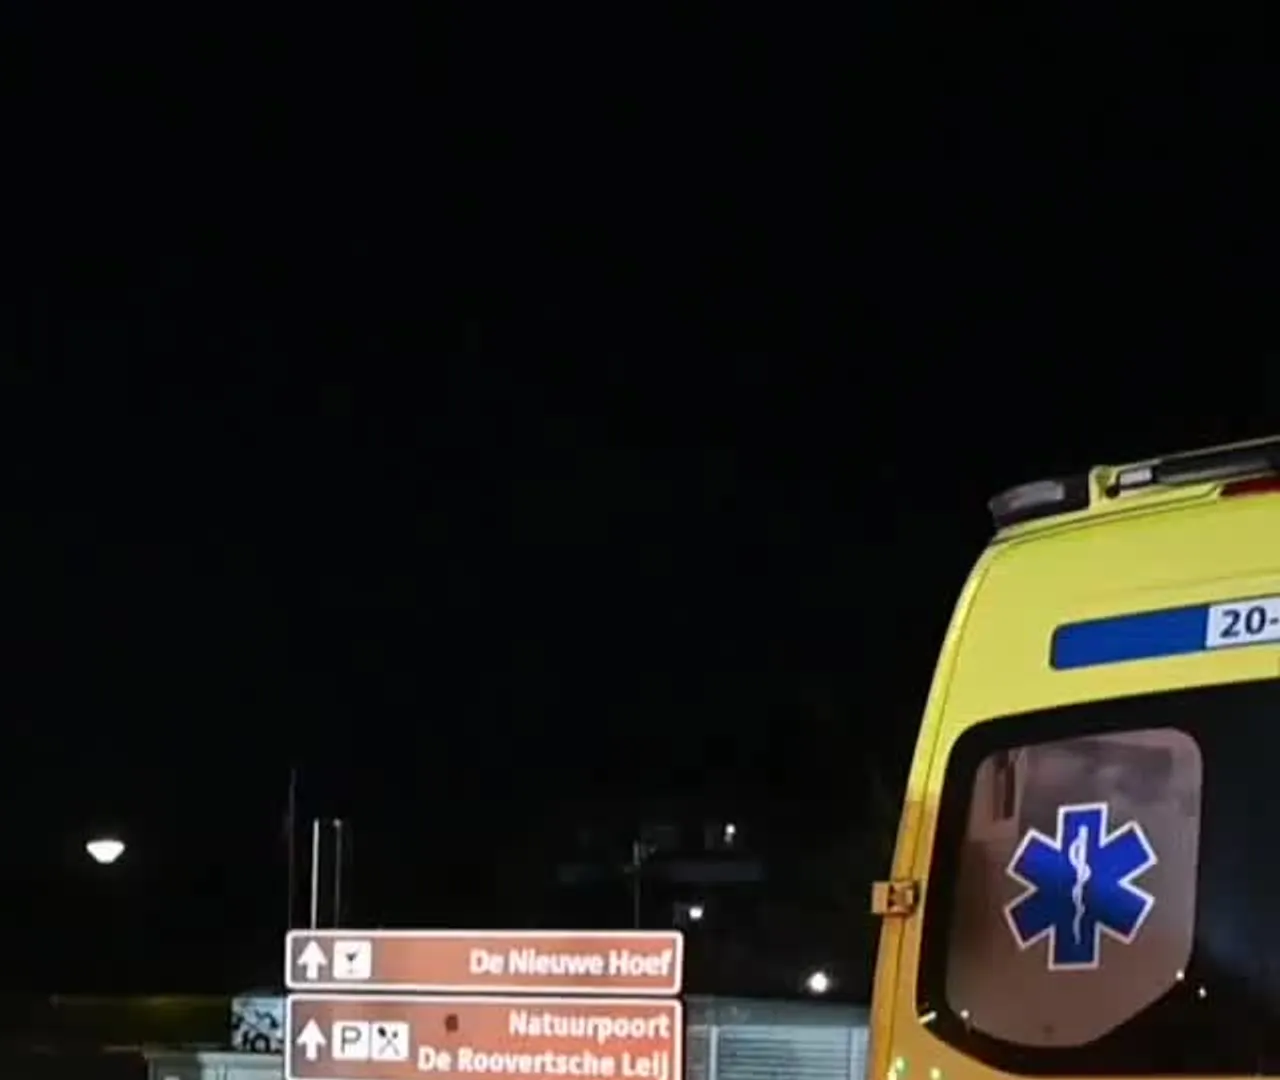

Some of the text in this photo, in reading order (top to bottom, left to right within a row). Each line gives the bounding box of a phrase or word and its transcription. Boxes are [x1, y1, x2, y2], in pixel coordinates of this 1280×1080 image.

[469, 948, 672, 977] De Nieuwe Hoef
[508, 1011, 671, 1043] Natuurpoort
[417, 1047, 453, 1072] De
[458, 1049, 615, 1076] Roovertsche
